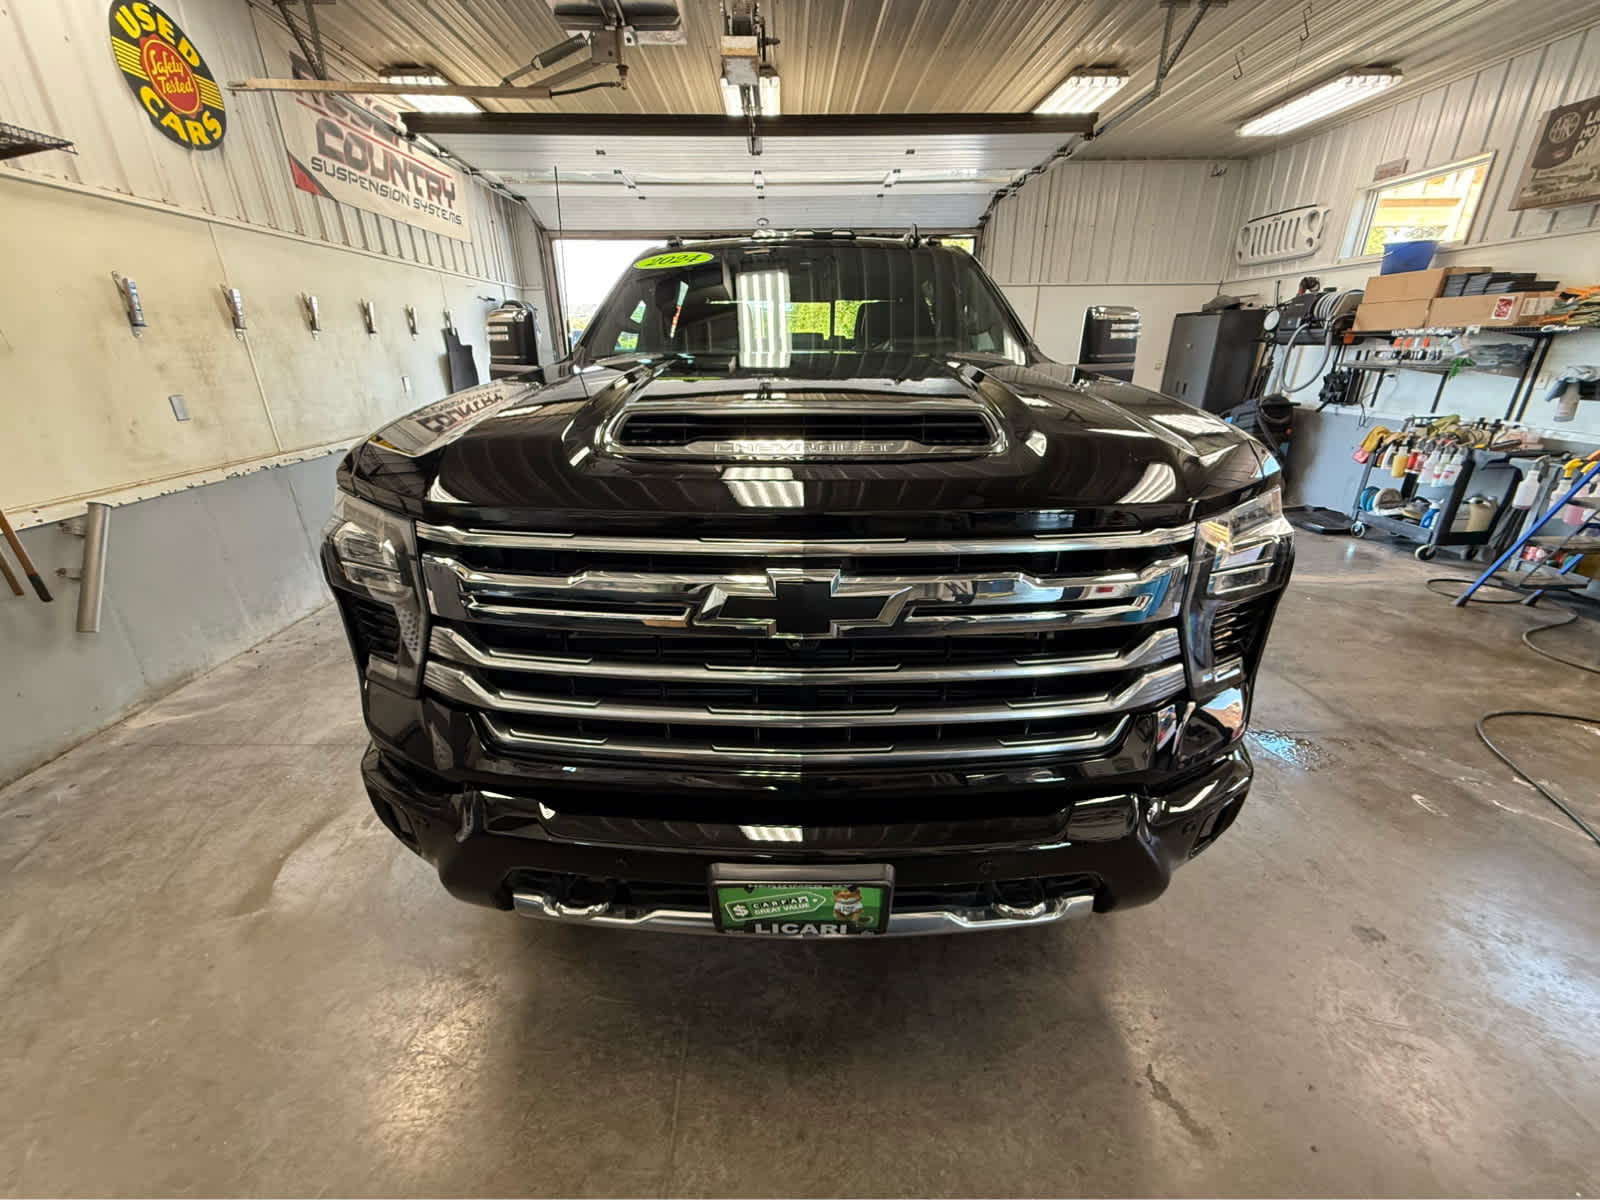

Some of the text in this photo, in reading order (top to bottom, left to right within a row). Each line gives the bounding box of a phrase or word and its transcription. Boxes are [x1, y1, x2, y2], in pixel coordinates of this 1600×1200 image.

[115, 2, 200, 67] USED
[149, 49, 184, 77] Safety
[157, 75, 194, 94] Tested
[140, 85, 222, 145] CARS
[315, 117, 456, 209] COUNTRY
[311, 156, 463, 225] SUSPENSION SYSTEMS
[647, 253, 702, 266] 2024
[755, 923, 847, 935] LICARI
